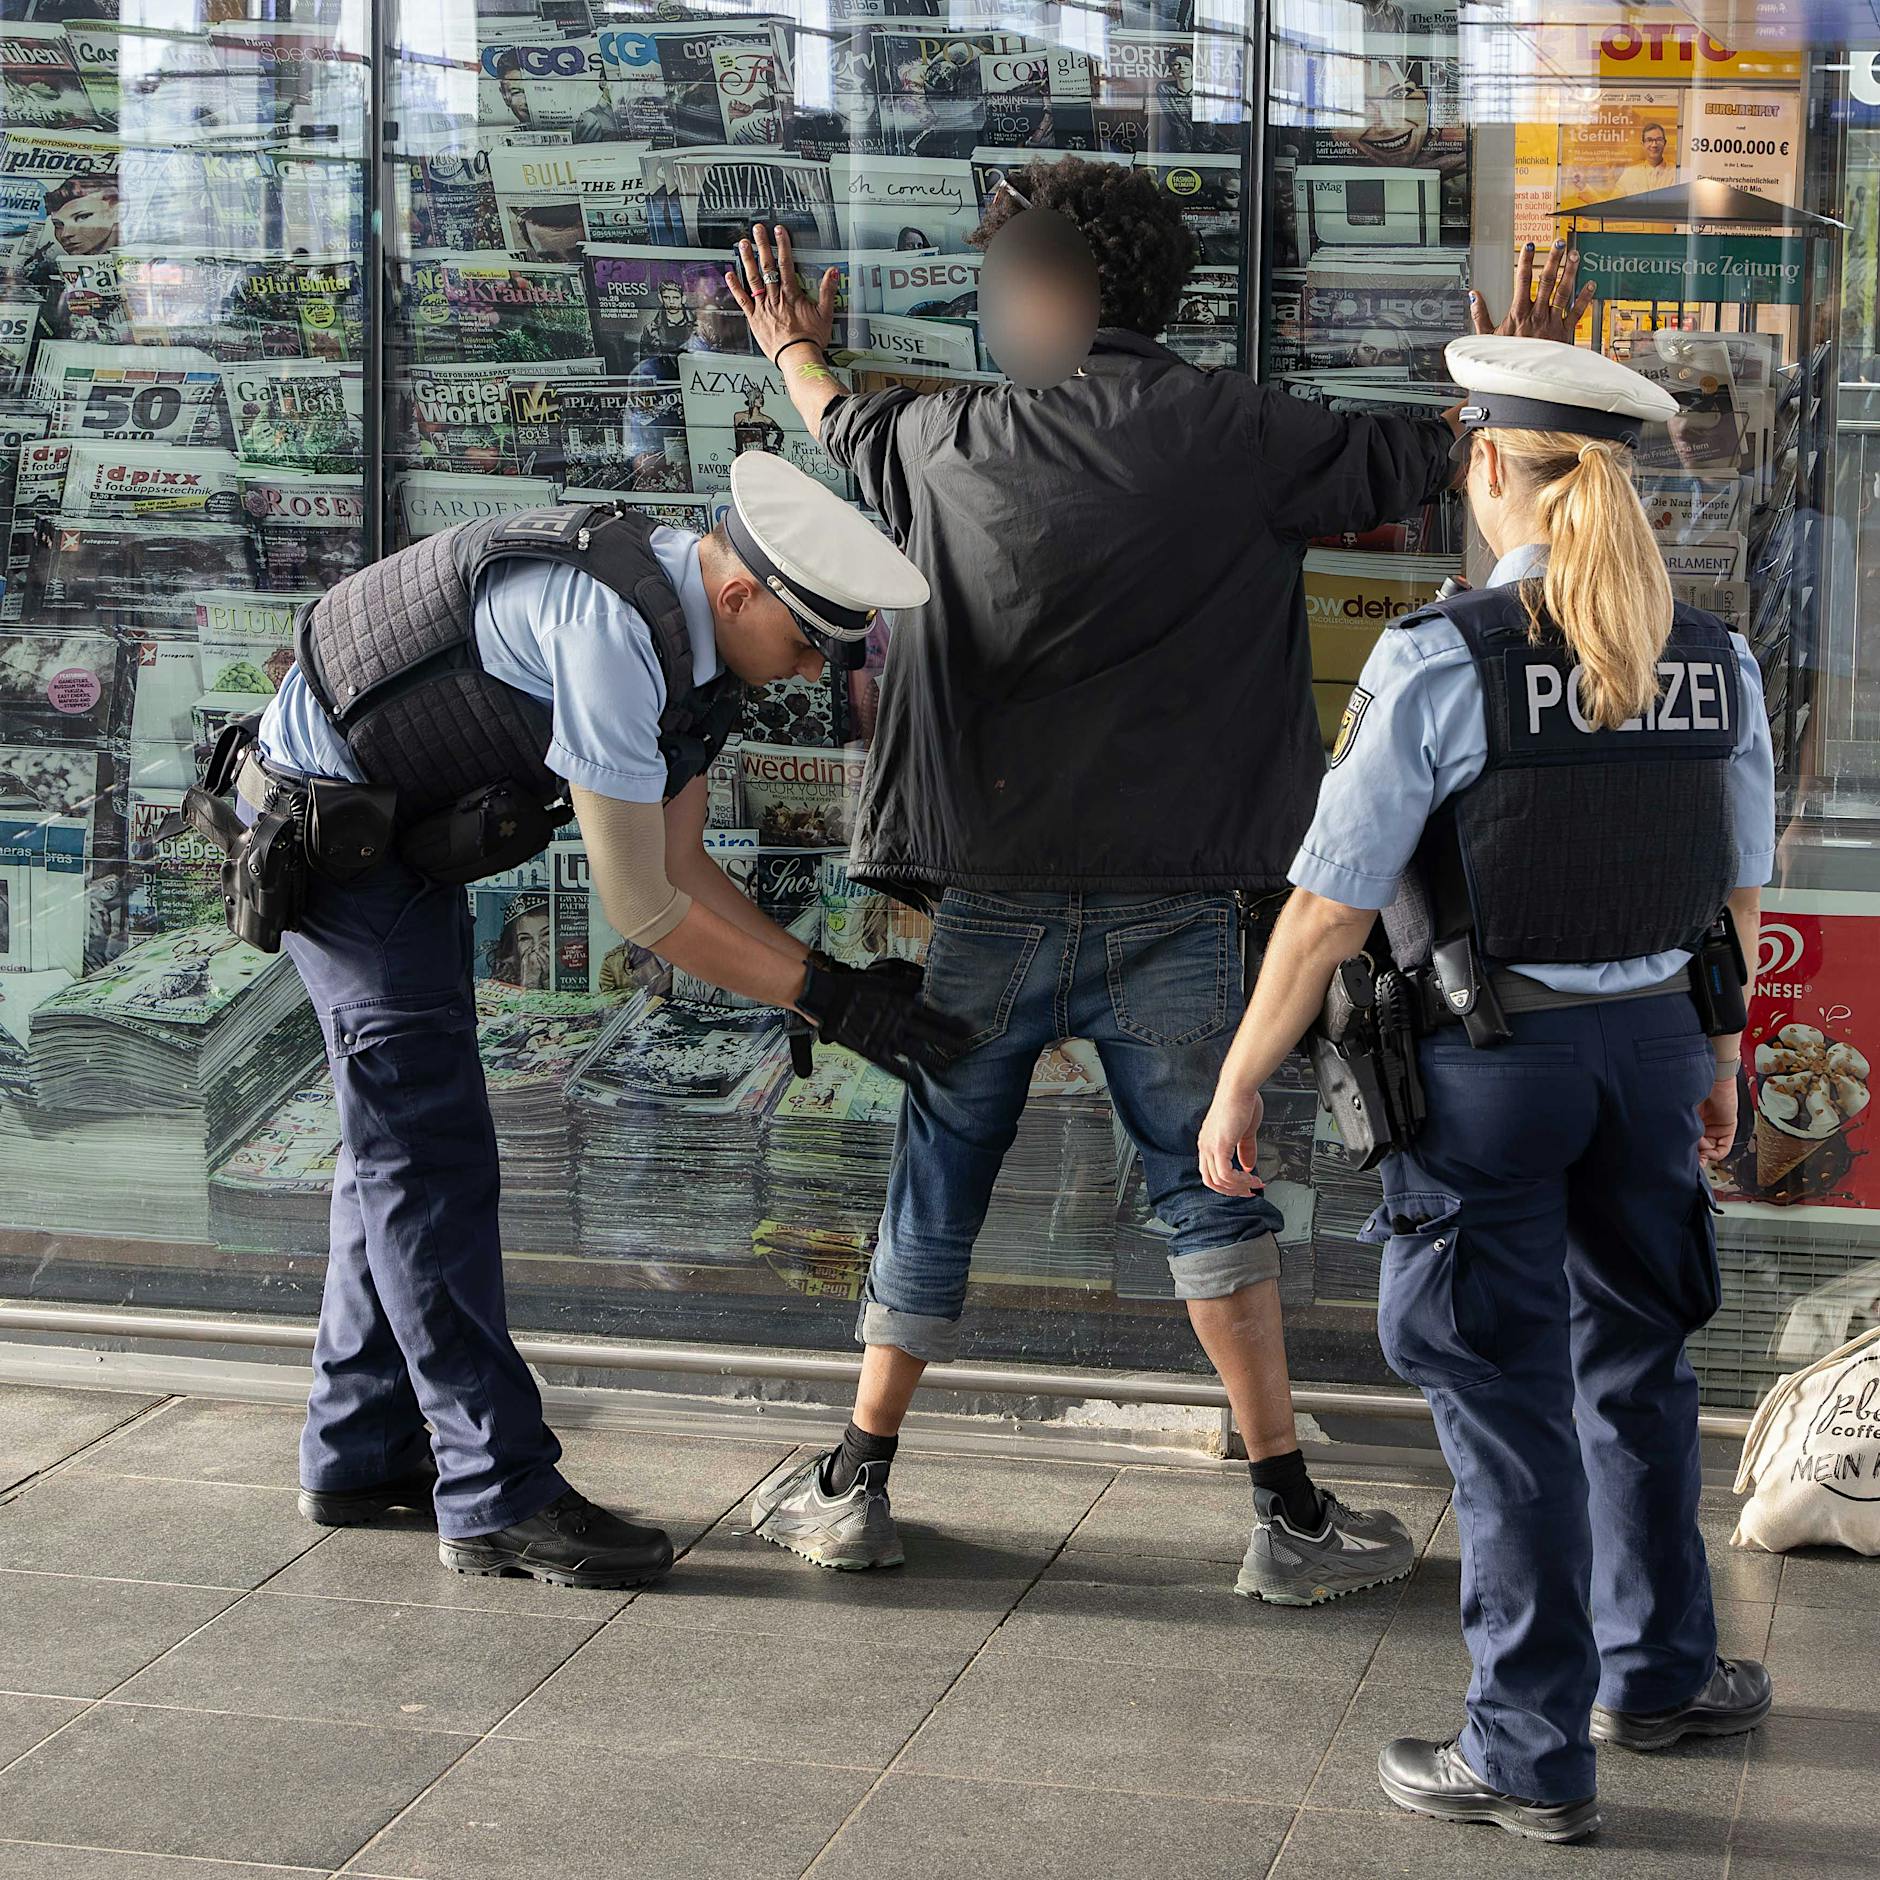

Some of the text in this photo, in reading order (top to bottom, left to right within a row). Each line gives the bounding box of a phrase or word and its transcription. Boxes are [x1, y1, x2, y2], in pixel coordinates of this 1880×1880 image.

[1411, 14, 1432, 23] The
[1576, 23, 1738, 61] LOTTO
[260, 47, 342, 64] special
[518, 45, 588, 76] GQ
[1093, 63, 1243, 79] INTERNAONAL
[993, 117, 1030, 133] 103
[1099, 122, 1150, 138] BABY
[31, 138, 78, 150] PHOTOSHOP
[1691, 138, 1789, 156] 39.000.000 €
[523, 160, 577, 186] BULL
[1697, 175, 1779, 185] Gnnwahrscheinlichkeit
[581, 181, 615, 192] THE
[849, 174, 962, 215] oh comely
[1315, 182, 1342, 193] uMag
[1530, 191, 1539, 200] ab
[1582, 250, 1800, 285] Süddeutsche Zeitung
[299, 276, 352, 292] Bunter
[607, 281, 649, 296] PRESS
[81, 385, 182, 430] 50
[606, 395, 656, 409] PLANT
[417, 401, 504, 425] World
[103, 430, 155, 441] FOTO
[518, 429, 550, 440] 2013
[794, 445, 825, 456] Turk.
[1692, 441, 1710, 451] fern
[788, 458, 839, 481] odels
[105, 481, 213, 497] fototipps+technik
[410, 498, 546, 517] GARDE
[1652, 498, 1667, 507] Die
[1702, 511, 1729, 520] heute
[1664, 557, 1731, 569] ARLAMENT
[209, 606, 294, 636] BLUM
[1525, 661, 1730, 735] POZEI
[764, 754, 790, 762] STEWART
[751, 779, 837, 798] COLOR YOUR
[560, 976, 574, 984] TON
[1790, 1453, 1864, 1484] MEIN
